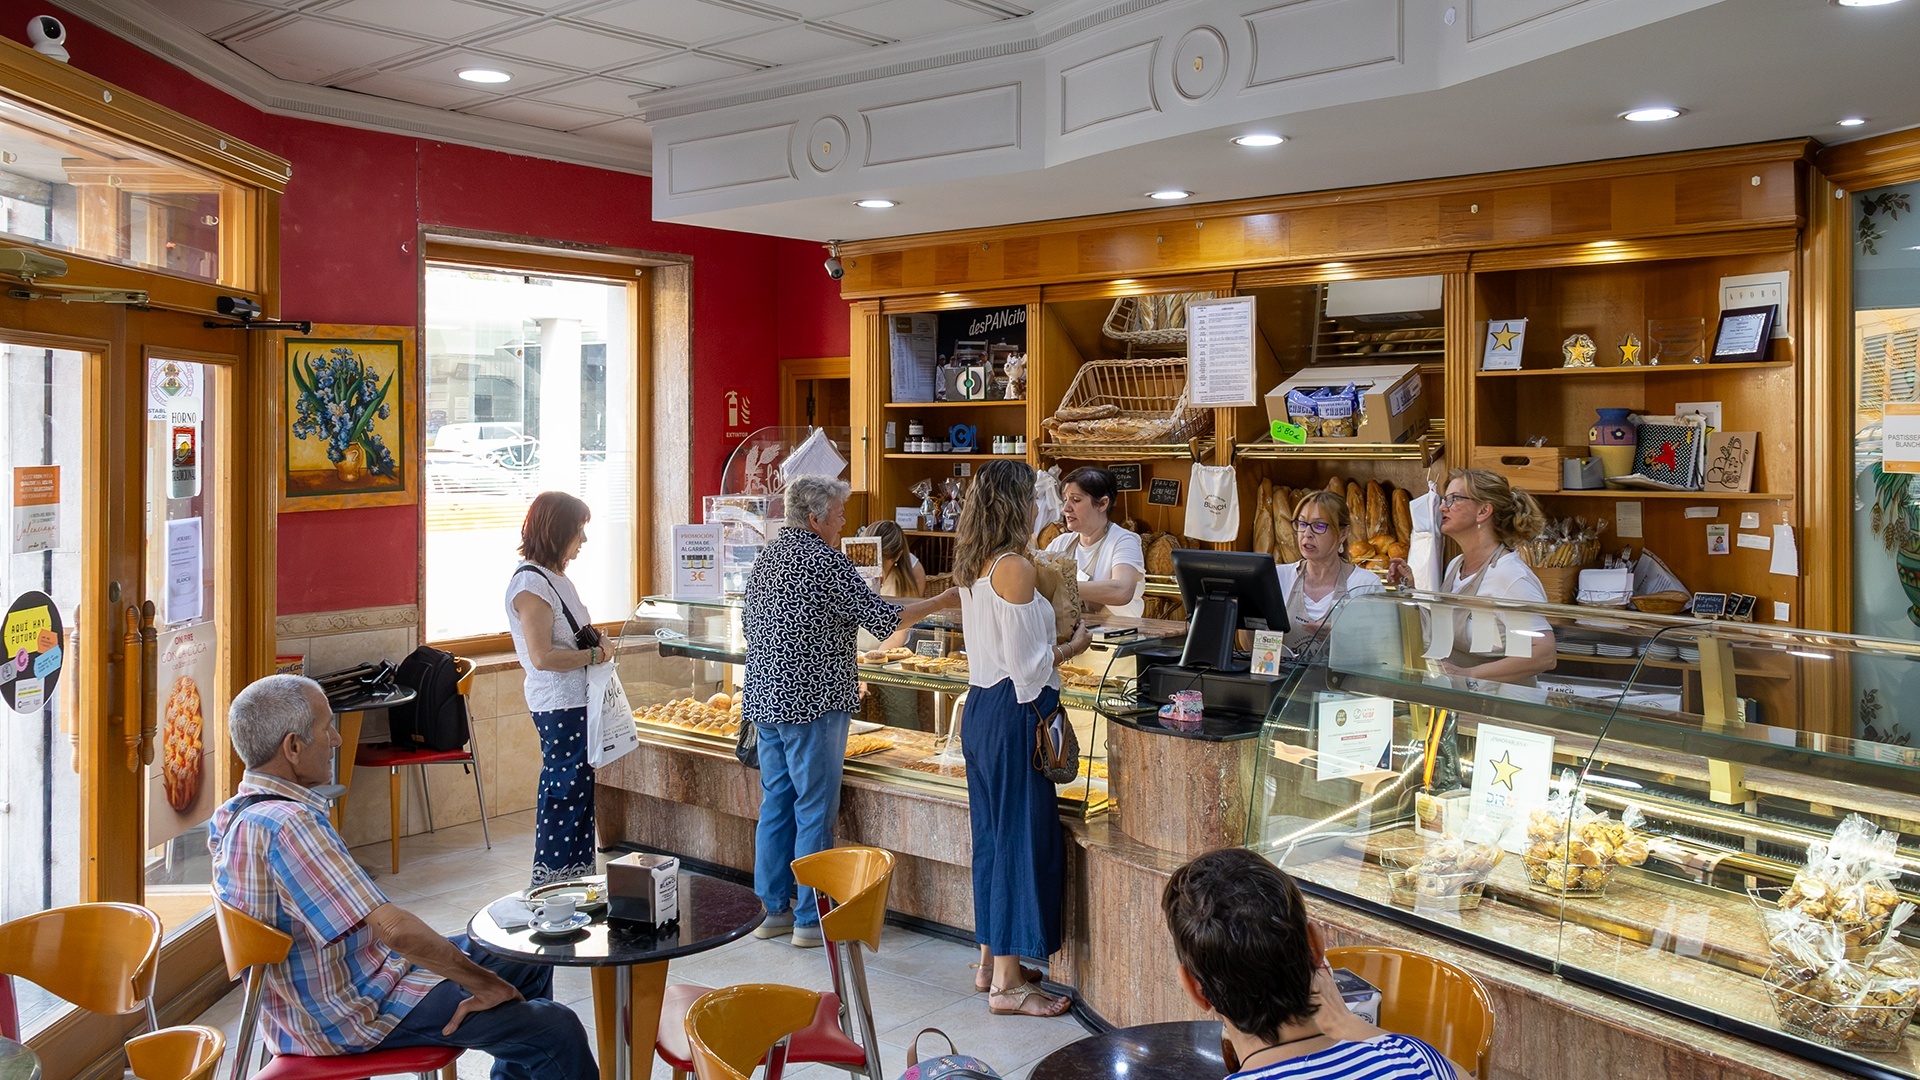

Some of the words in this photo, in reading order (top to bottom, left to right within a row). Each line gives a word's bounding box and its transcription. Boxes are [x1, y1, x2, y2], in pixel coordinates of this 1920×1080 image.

[968, 308, 1026, 336] desPANcito
[171, 412, 197, 424] HORNO
[690, 571, 706, 582] 3€
[11, 620, 29, 633] AQUÍ
[33, 619, 46, 628] HAY
[11, 631, 38, 646] FUTURO
